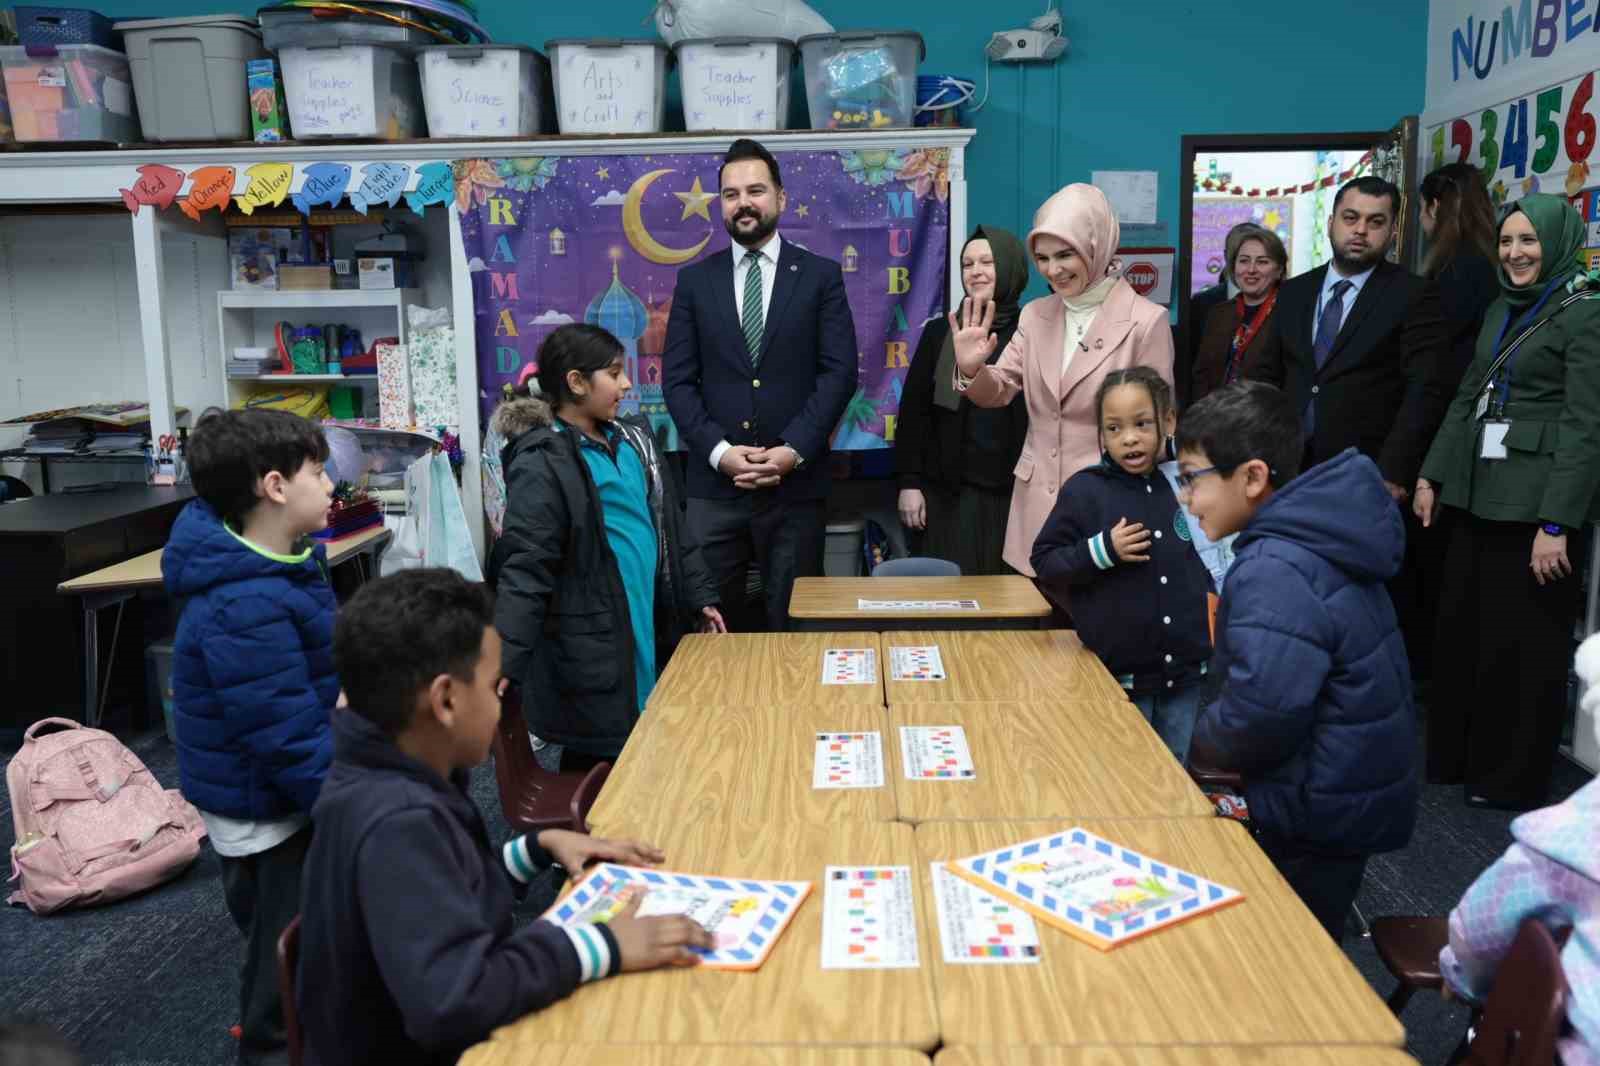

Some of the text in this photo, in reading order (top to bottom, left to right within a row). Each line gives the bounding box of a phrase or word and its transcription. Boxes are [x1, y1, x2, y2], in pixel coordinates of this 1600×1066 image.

[583, 60, 622, 89] Arts
[702, 65, 756, 83] Teacher
[450, 77, 505, 106] Science
[1452, 119, 1472, 164] 2
[1480, 108, 1498, 185] 3
[1500, 98, 1528, 178] 4
[1531, 87, 1562, 174] 5
[1564, 71, 1596, 163] 6
[139, 175, 167, 195] Red
[194, 174, 231, 205] Orange
[248, 170, 288, 202] Yellow
[307, 173, 341, 199] Blue
[1128, 272, 1154, 285] STOP
